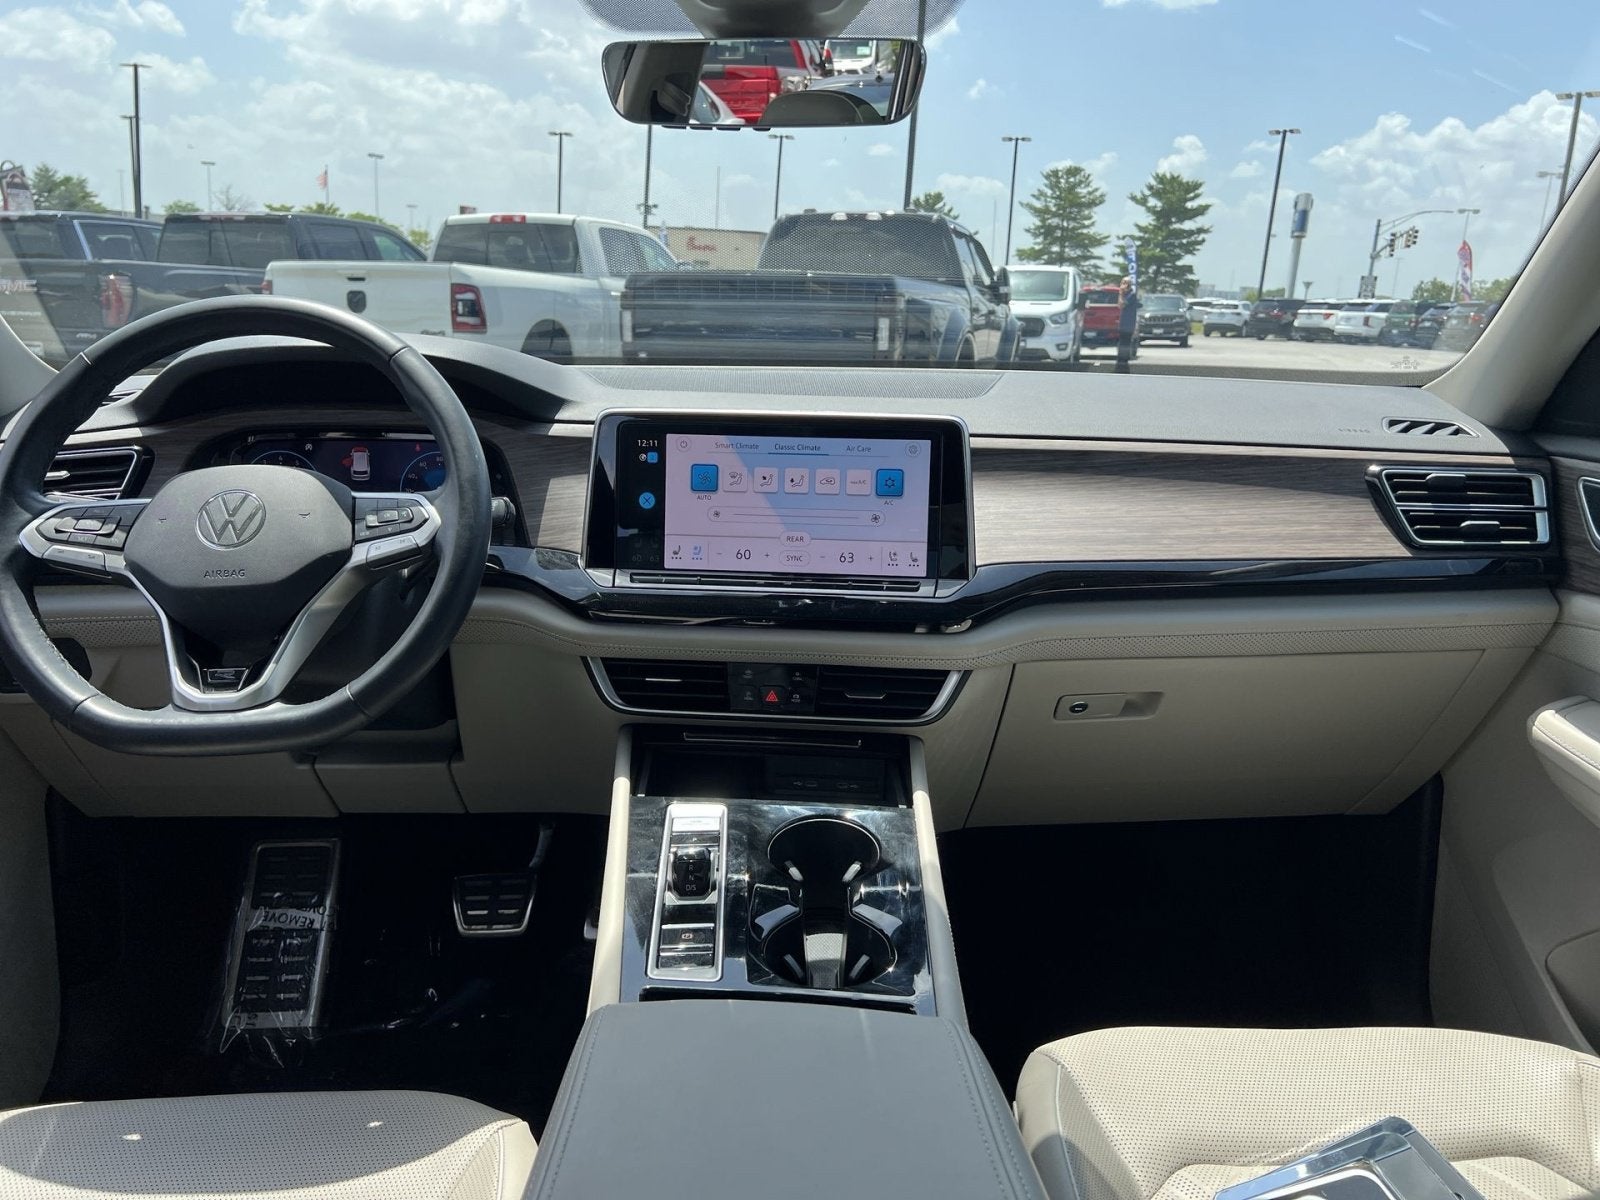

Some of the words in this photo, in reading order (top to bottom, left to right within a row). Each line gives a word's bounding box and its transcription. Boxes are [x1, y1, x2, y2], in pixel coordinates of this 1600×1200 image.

[638, 439, 658, 447] 12:11
[715, 441, 735, 449] Smart
[736, 441, 759, 450] Climate
[774, 443, 796, 451] Classic
[786, 535, 805, 543] REAR
[735, 549, 752, 560] 60
[786, 554, 803, 562] SYNC
[839, 552, 855, 564] 63
[203, 568, 246, 578] AIRBAG
[263, 910, 315, 929] REMOVE
